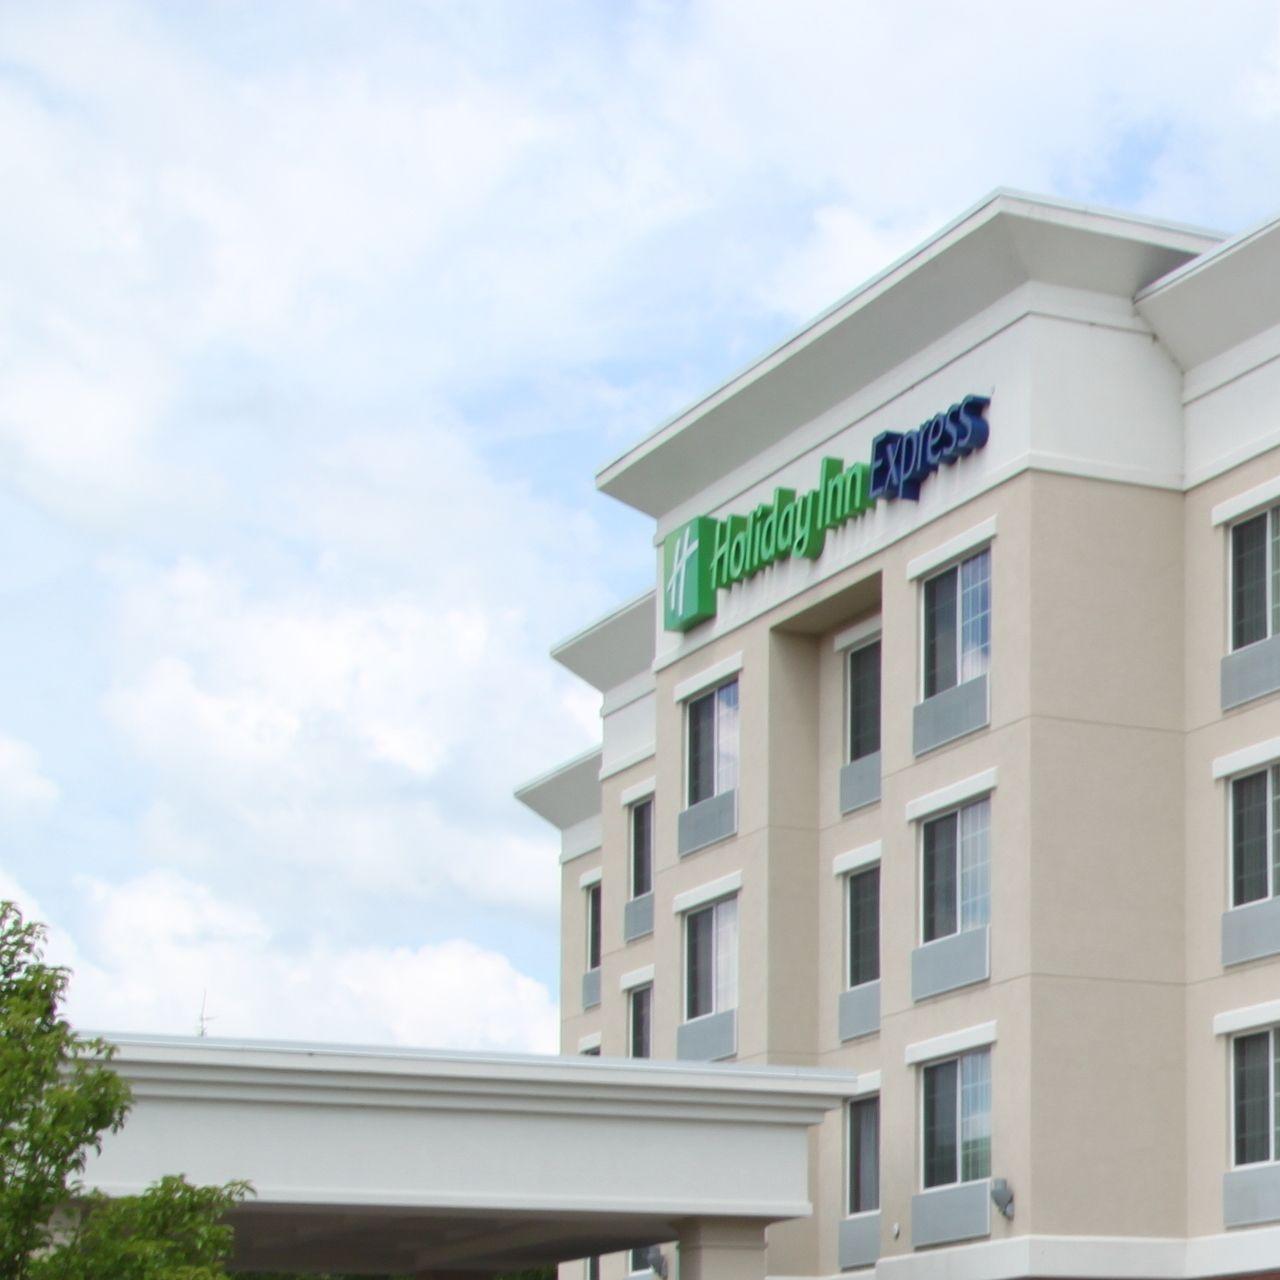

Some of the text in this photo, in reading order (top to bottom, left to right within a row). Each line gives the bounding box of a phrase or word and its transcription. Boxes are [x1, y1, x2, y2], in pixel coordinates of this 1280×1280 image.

[710, 394, 992, 591] Holiday Inn Express
